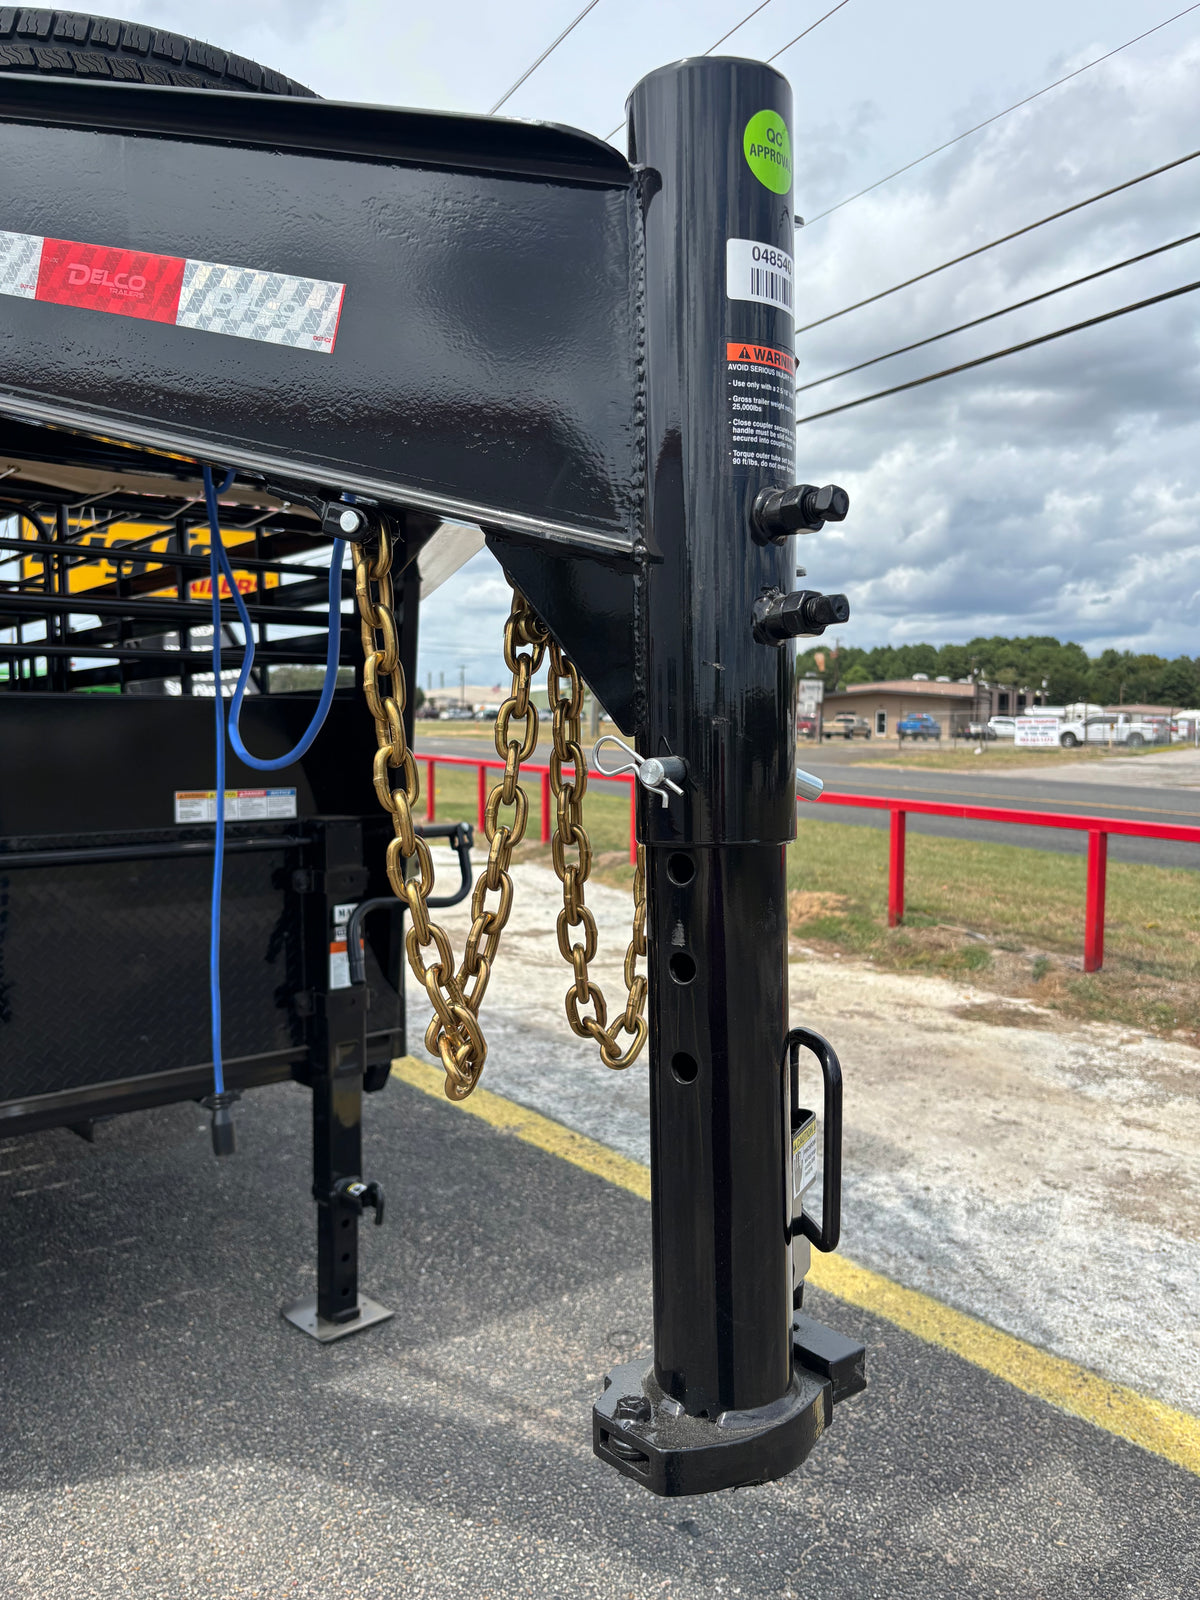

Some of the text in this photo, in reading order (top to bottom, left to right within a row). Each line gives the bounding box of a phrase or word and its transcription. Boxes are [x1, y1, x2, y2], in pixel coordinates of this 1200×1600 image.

[766, 127, 783, 148] QC
[67, 263, 147, 291] DELCO
[109, 287, 145, 299] TRAILERS
[727, 363, 750, 372] AVOID
[750, 364, 776, 376] SERIOUS
[732, 379, 746, 388] Use
[746, 381, 760, 390] only
[761, 383, 772, 391] with
[732, 395, 752, 404] Gross
[753, 397, 770, 406] trailer
[732, 403, 762, 412] 25,000lbs
[732, 418, 752, 427] Close
[752, 421, 773, 430] coupler
[732, 427, 754, 435] handle
[755, 429, 769, 437] must
[770, 430, 777, 438] be
[732, 435, 758, 443] secured
[759, 436, 770, 444] into
[732, 450, 755, 459] Torque
[756, 452, 771, 460] outer
